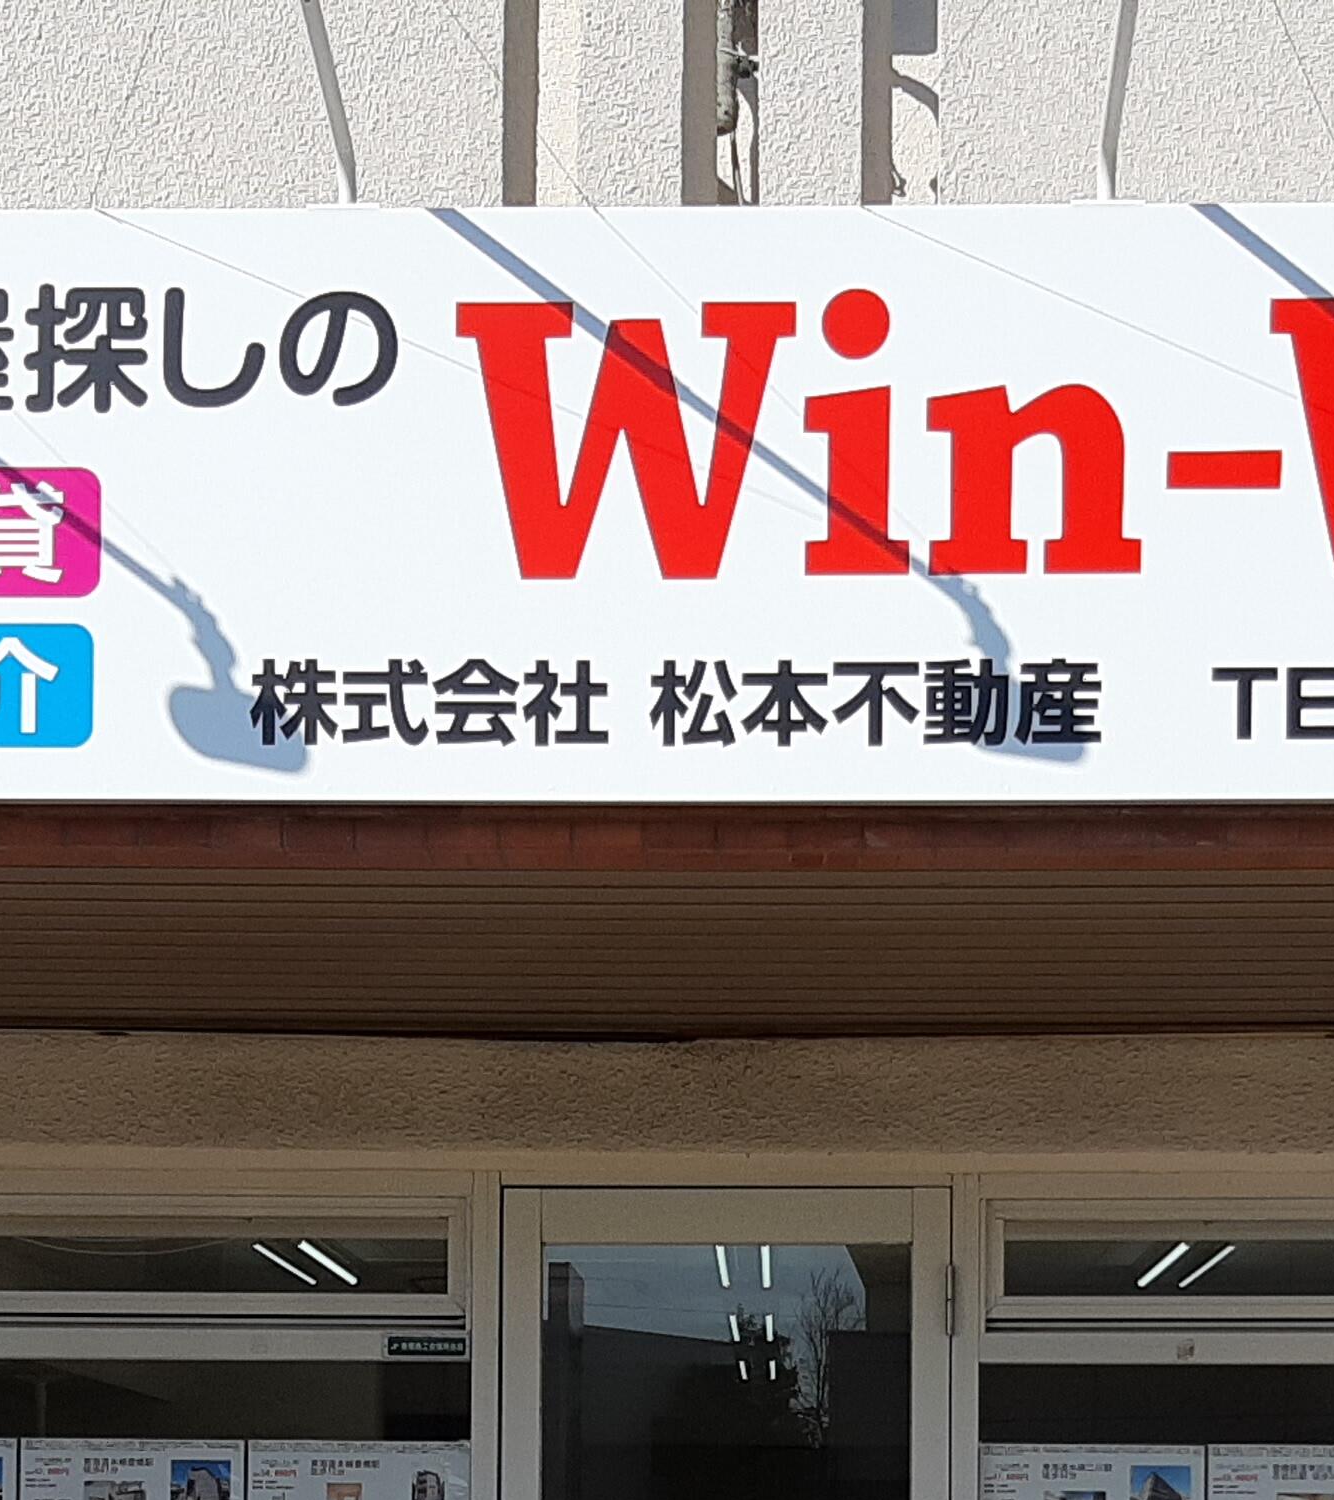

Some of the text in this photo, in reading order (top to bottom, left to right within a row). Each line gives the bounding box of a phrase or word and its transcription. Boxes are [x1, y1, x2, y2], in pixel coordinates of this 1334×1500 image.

[249, 657, 1103, 748] 株式会社 松本不動産
